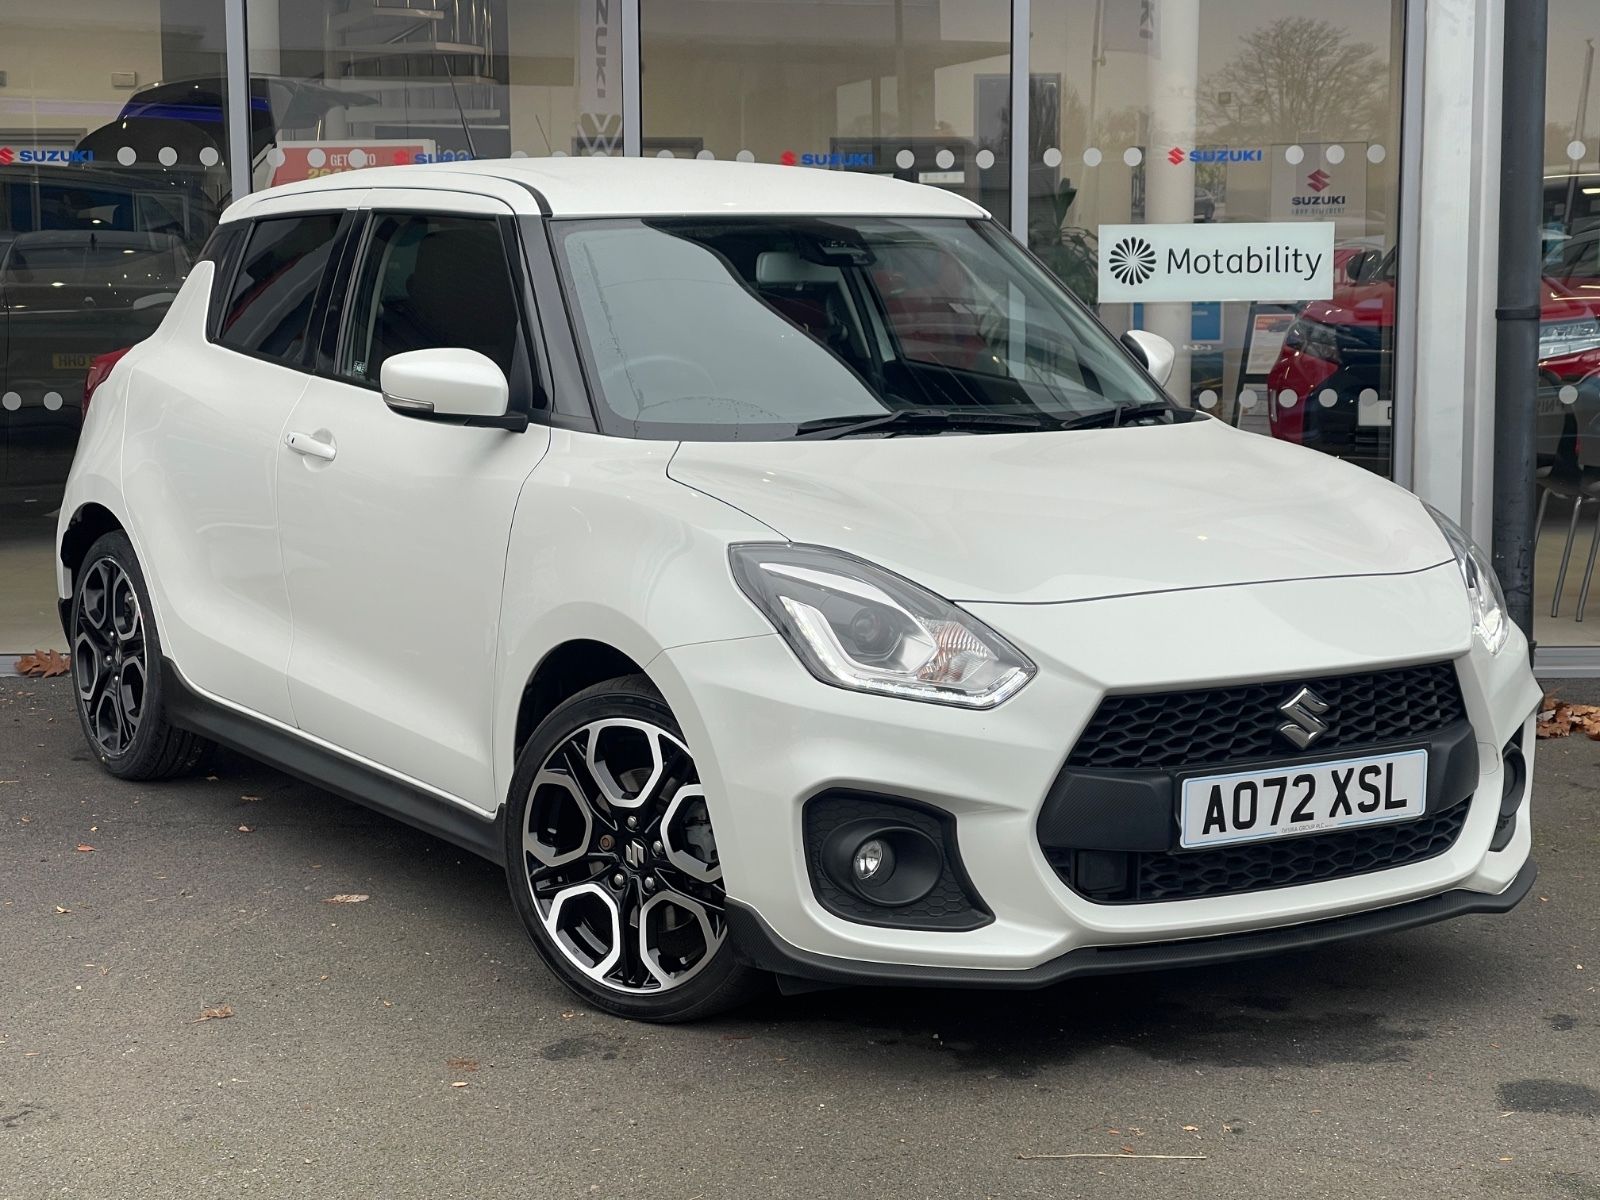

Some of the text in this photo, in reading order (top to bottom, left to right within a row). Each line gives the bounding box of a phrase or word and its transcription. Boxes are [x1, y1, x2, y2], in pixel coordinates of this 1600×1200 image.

[19, 149, 95, 162] SUZUKI
[330, 154, 348, 167] GET
[801, 152, 875, 166] SUZUKI
[1189, 149, 1262, 162] SUZUKI
[1291, 195, 1346, 206] SUZUKI
[1167, 245, 1322, 281] Motability
[1202, 762, 1408, 835] AO72 XSL
